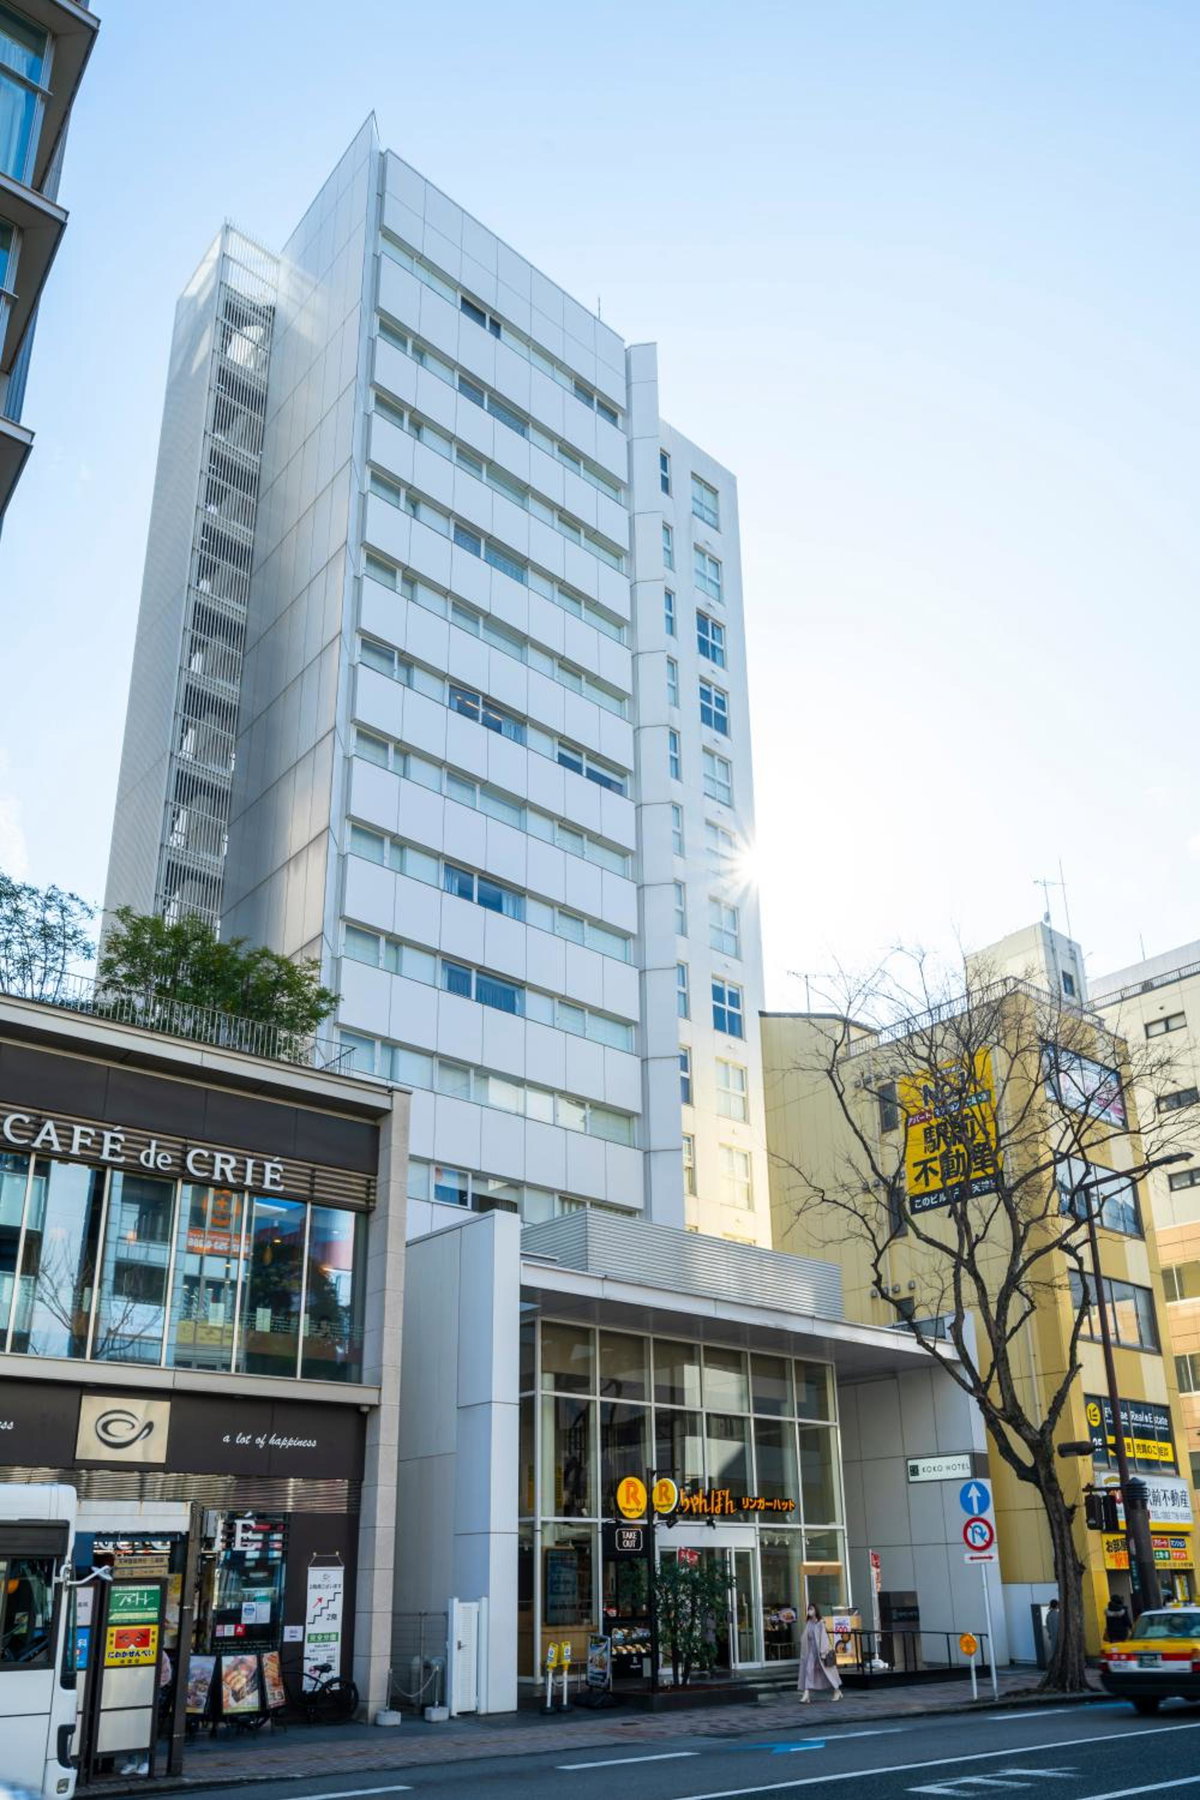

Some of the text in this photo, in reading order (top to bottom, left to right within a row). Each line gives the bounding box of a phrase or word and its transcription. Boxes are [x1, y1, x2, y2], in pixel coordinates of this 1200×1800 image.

[3, 1113, 285, 1192] CAFÉ de CRIÉ
[912, 1141, 994, 1187] 不動産
[222, 1432, 317, 1449] a lot of happiness
[922, 1462, 971, 1473] KOKO HOTEL
[625, 1480, 641, 1507] R
[658, 1482, 672, 1503] R
[742, 1496, 796, 1512] リンガーハット
[621, 1531, 637, 1540] TAKE
[622, 1540, 636, 1548] OUT
